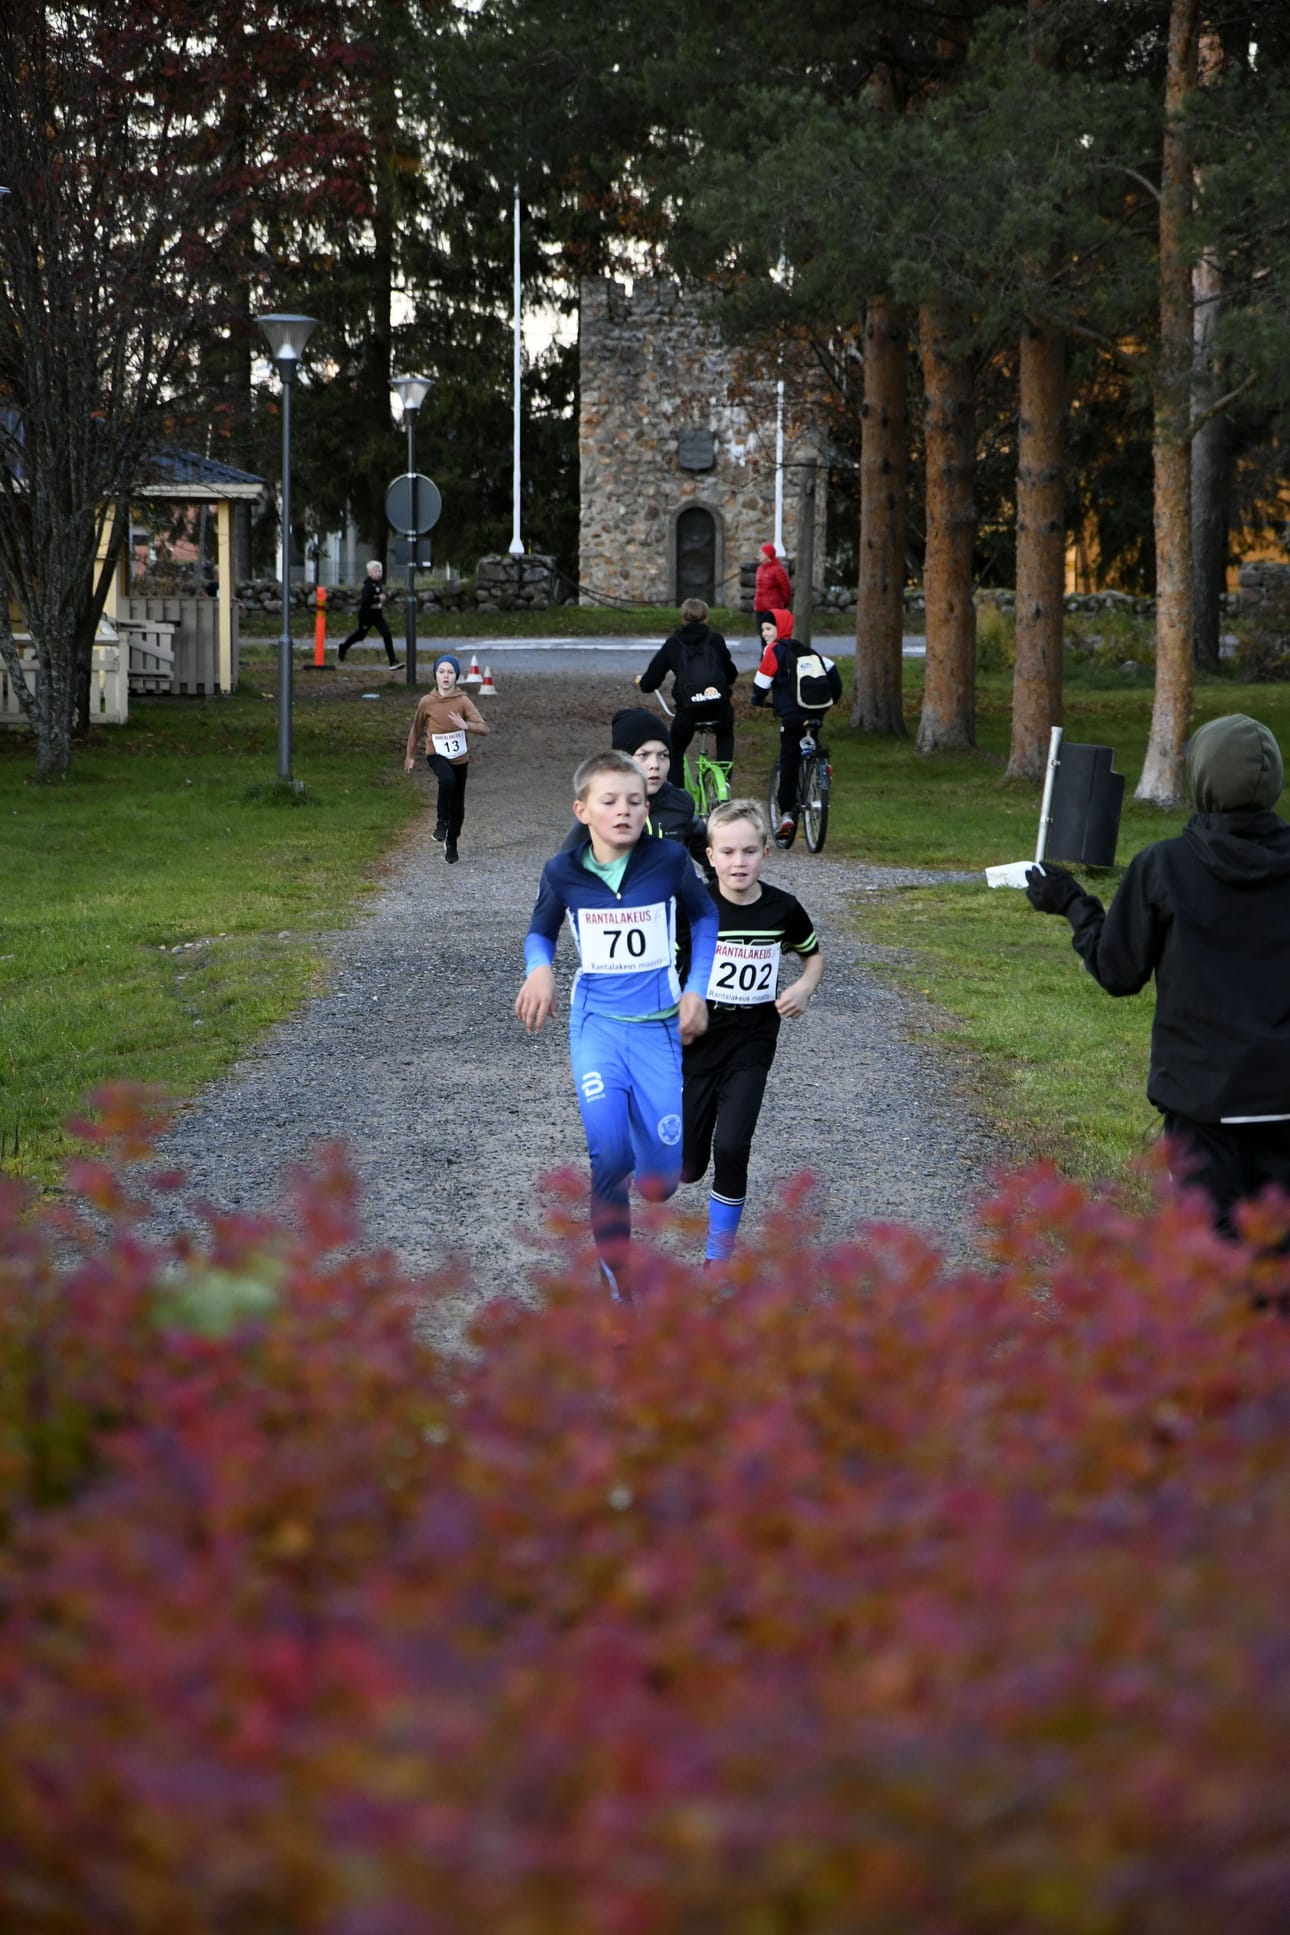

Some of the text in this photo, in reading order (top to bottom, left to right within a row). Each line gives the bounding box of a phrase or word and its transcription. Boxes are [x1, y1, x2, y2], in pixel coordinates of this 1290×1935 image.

[444, 740, 460, 752] 13
[585, 910, 652, 925] RANTALAKEUS
[603, 928, 646, 958] 70
[716, 944, 772, 960] RANTALAKEUS
[716, 962, 772, 991] 202
